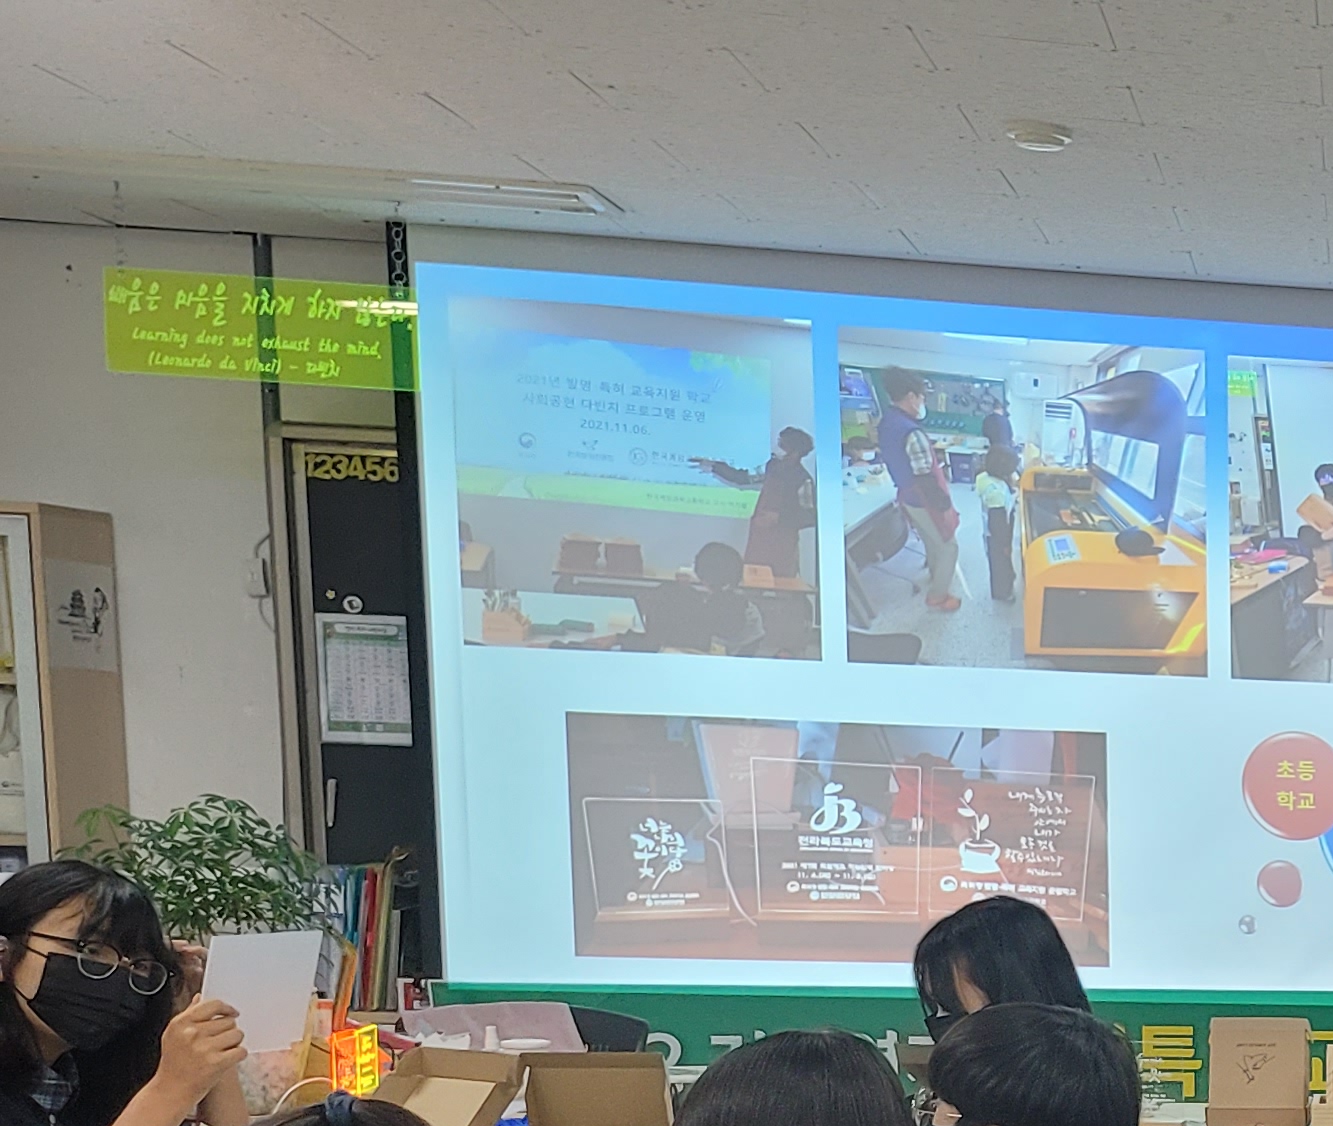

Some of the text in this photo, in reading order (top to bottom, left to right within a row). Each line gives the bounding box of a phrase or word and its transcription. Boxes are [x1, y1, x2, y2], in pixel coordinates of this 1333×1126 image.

[175, 281, 227, 326] 마음을
[241, 288, 295, 316] 지치게
[307, 289, 341, 320] 하지
[132, 327, 189, 349] Learning
[196, 332, 225, 347] does
[232, 334, 254, 348] not
[261, 337, 310, 352] exhaust
[319, 339, 340, 354] the
[149, 351, 211, 370] (Leonardo
[219, 355, 237, 370] da
[245, 358, 283, 375] Vinci)
[566, 376, 592, 392] 발명
[600, 380, 625, 394] 특허
[630, 384, 681, 401] 교육지원
[581, 398, 620, 414] 다빈치
[625, 404, 675, 420] 프로그램
[682, 409, 706, 424] 운영
[580, 418, 651, 436] 2021.11.06.
[305, 453, 399, 482] 123456
[1276, 760, 1316, 781] 초등
[1276, 790, 1316, 812] 학교
[1141, 1025, 1202, 1097] 특
